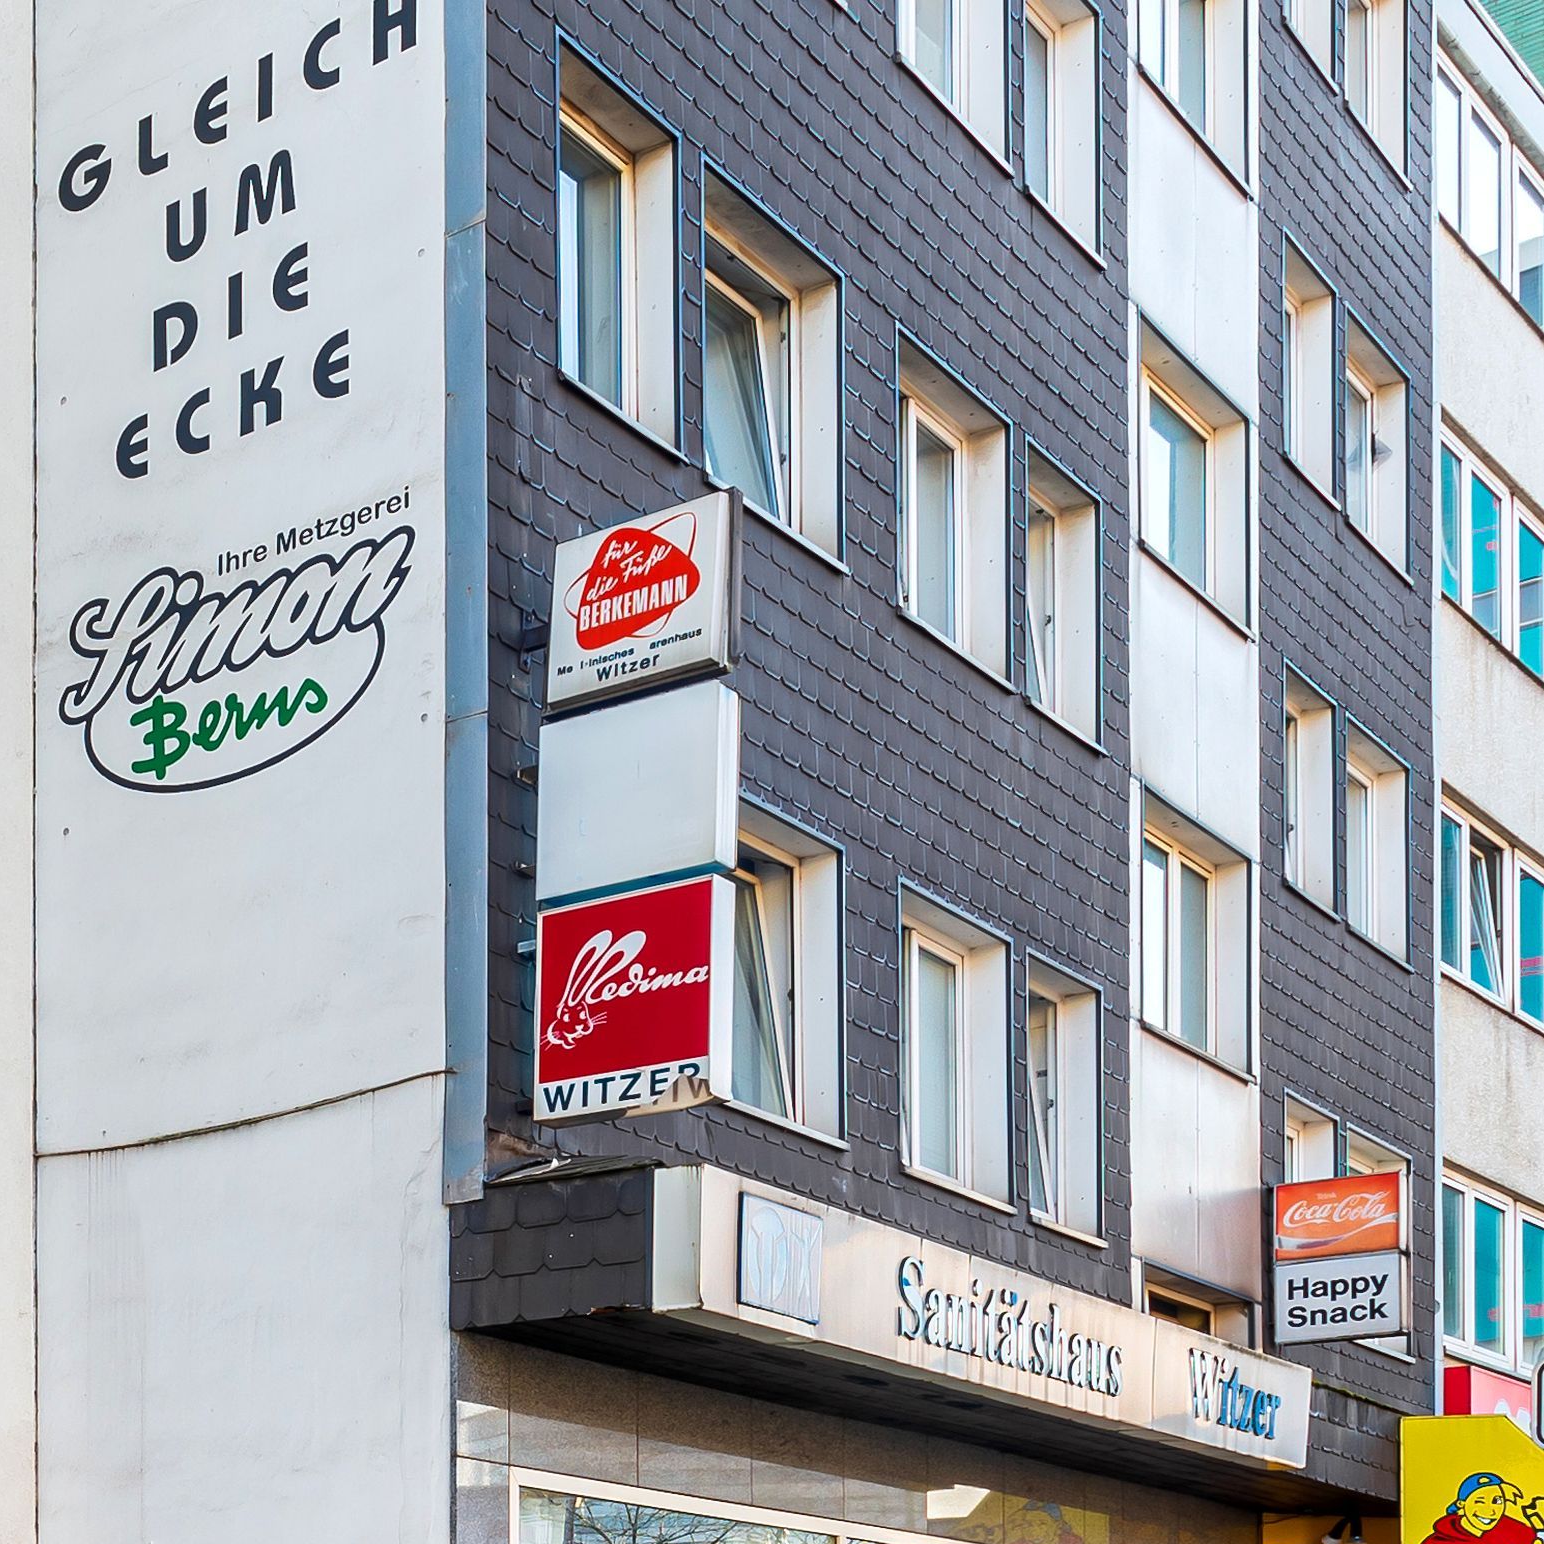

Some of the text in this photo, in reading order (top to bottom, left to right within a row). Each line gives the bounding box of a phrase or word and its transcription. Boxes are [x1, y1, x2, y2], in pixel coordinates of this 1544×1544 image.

[58, 0, 417, 212] GLEICH
[165, 149, 297, 262] UM
[153, 242, 309, 373] DIE
[116, 329, 350, 479] ECKE
[217, 486, 411, 576] Ihre Metzgerei
[579, 574, 688, 632] BERKEMANN
[129, 677, 329, 780] Berns
[1287, 1274, 1389, 1301] Happy
[1287, 1298, 1389, 1328] Snack
[897, 1256, 1282, 1440] Sanitätshaus Witzer
